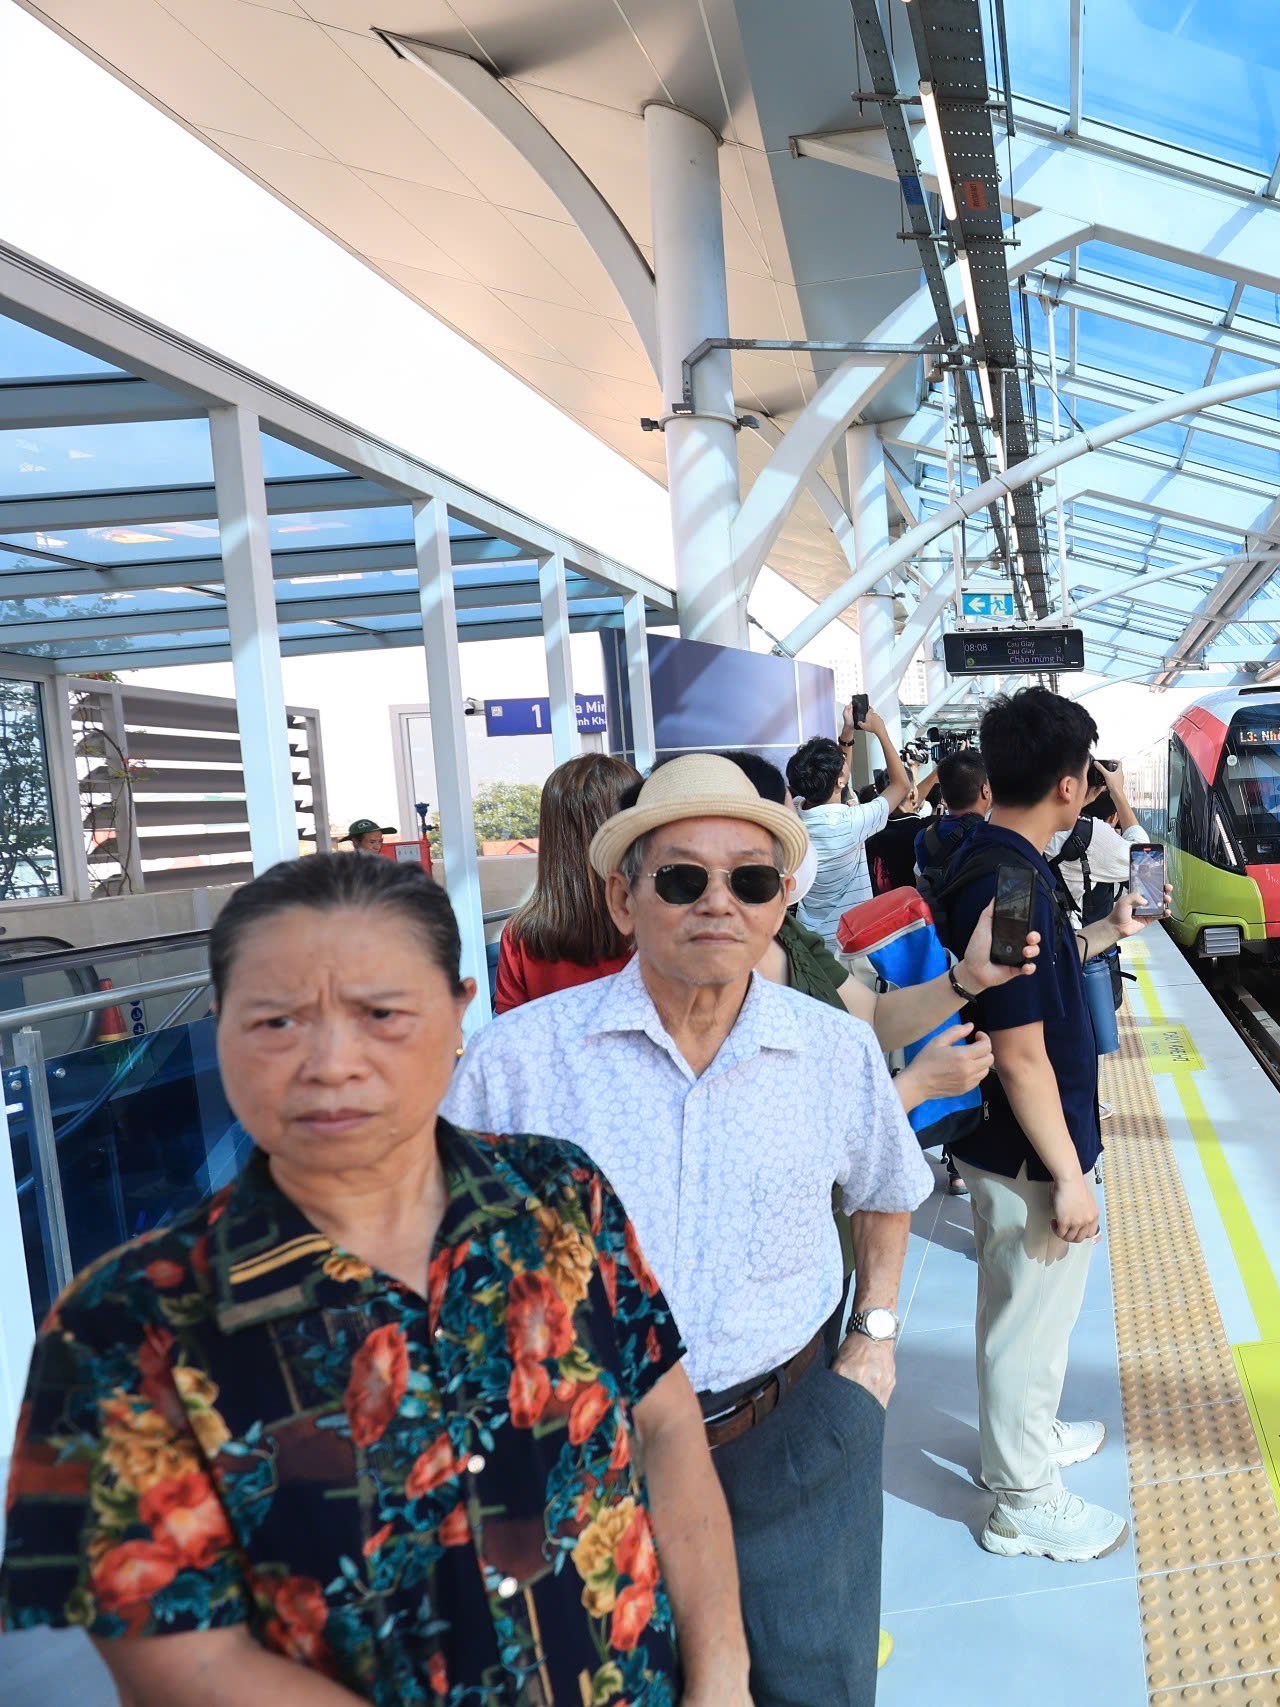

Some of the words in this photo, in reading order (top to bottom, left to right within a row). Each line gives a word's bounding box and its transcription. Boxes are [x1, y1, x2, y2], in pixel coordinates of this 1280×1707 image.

[964, 643, 988, 652] 08:08
[531, 704, 542, 728] 1
[1240, 731, 1258, 743] L3:
